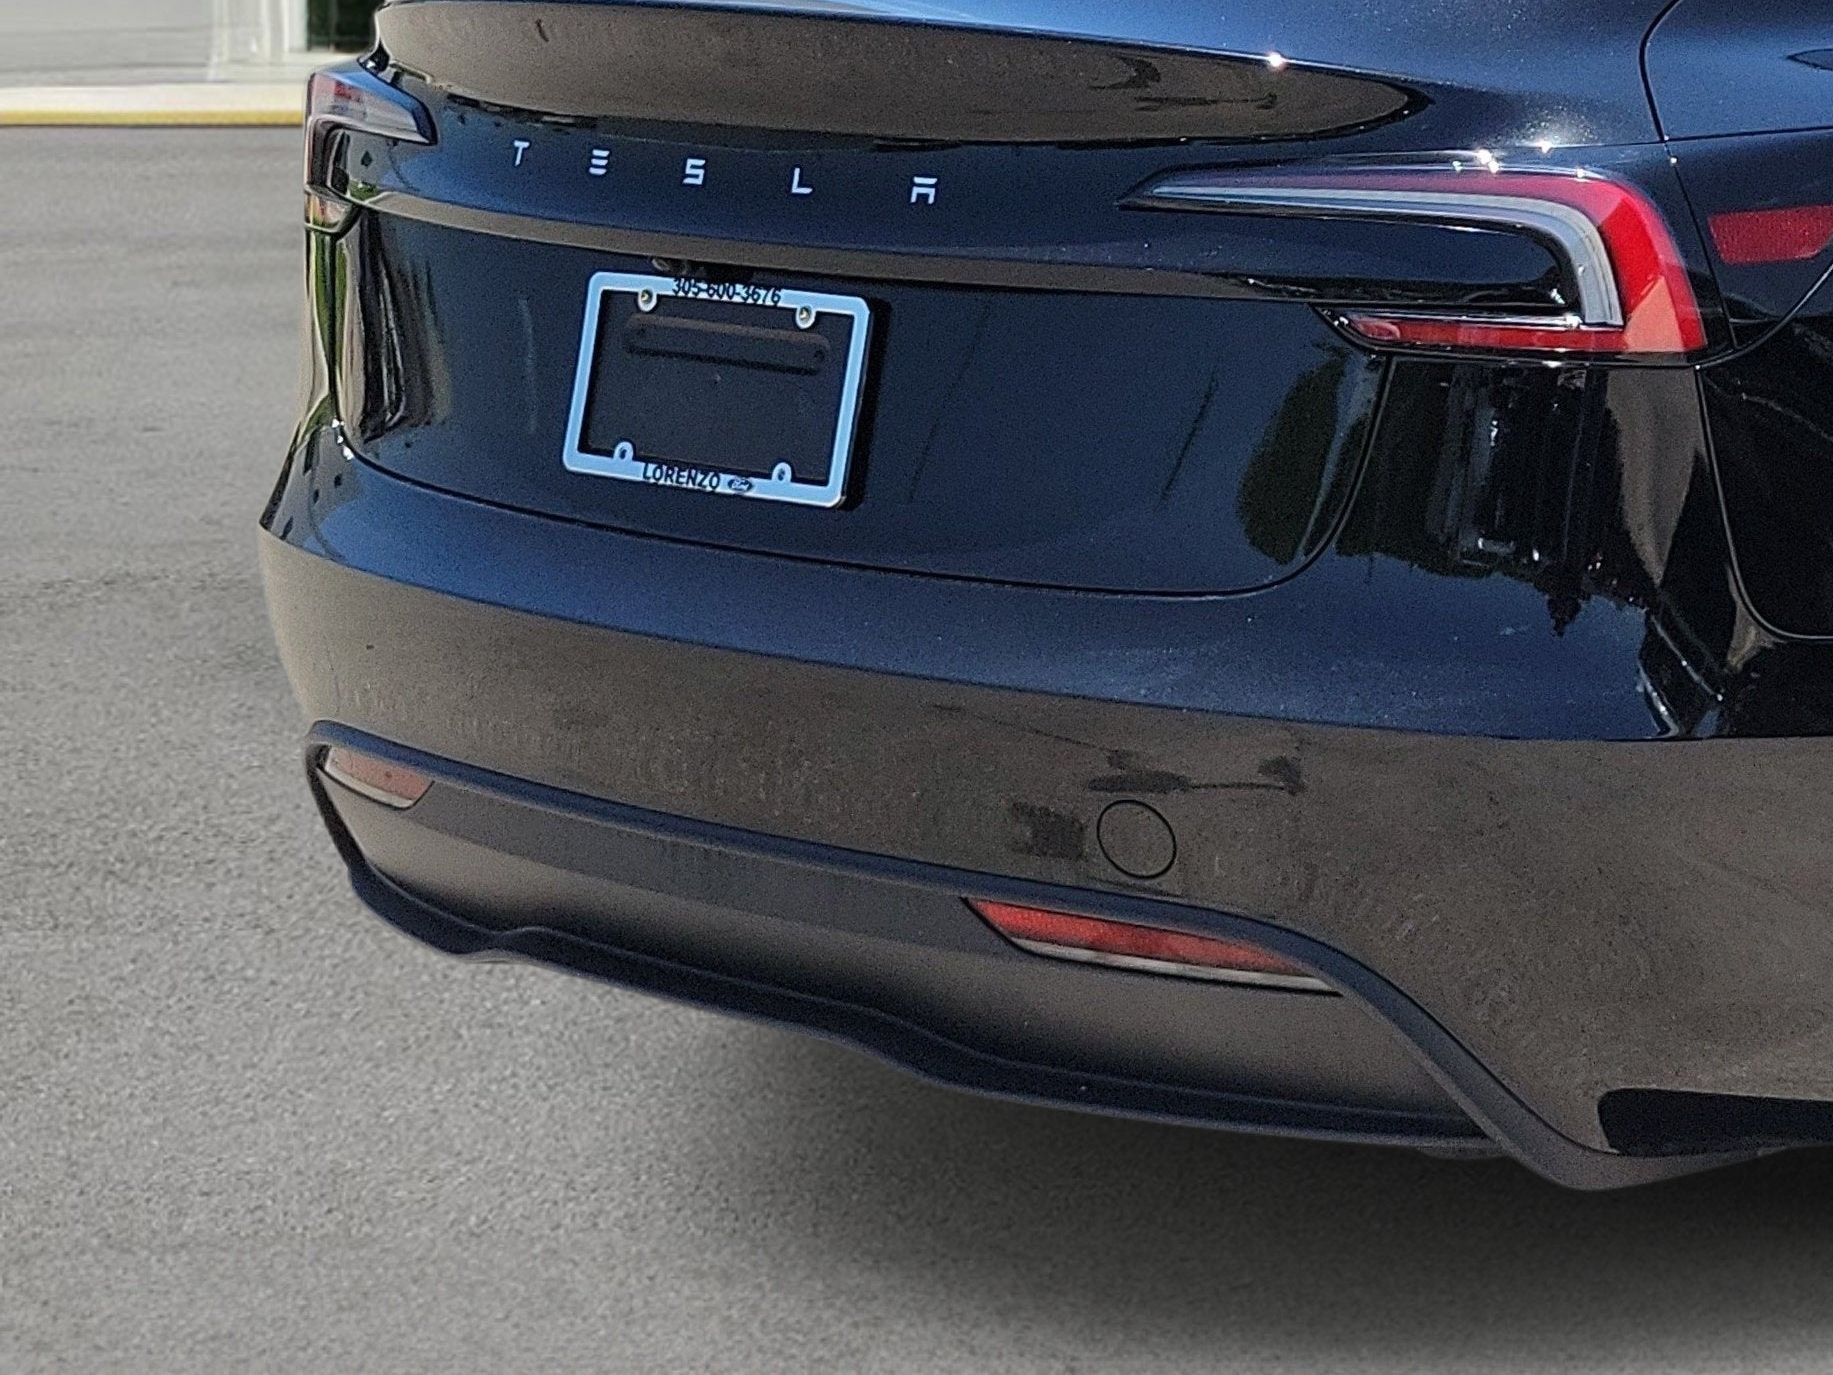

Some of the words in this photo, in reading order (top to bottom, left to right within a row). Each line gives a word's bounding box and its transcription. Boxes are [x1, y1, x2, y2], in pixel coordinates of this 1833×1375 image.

[513, 140, 938, 204] TESLA
[672, 277, 781, 306] 305-600-3676
[642, 462, 721, 491] LORENZO
